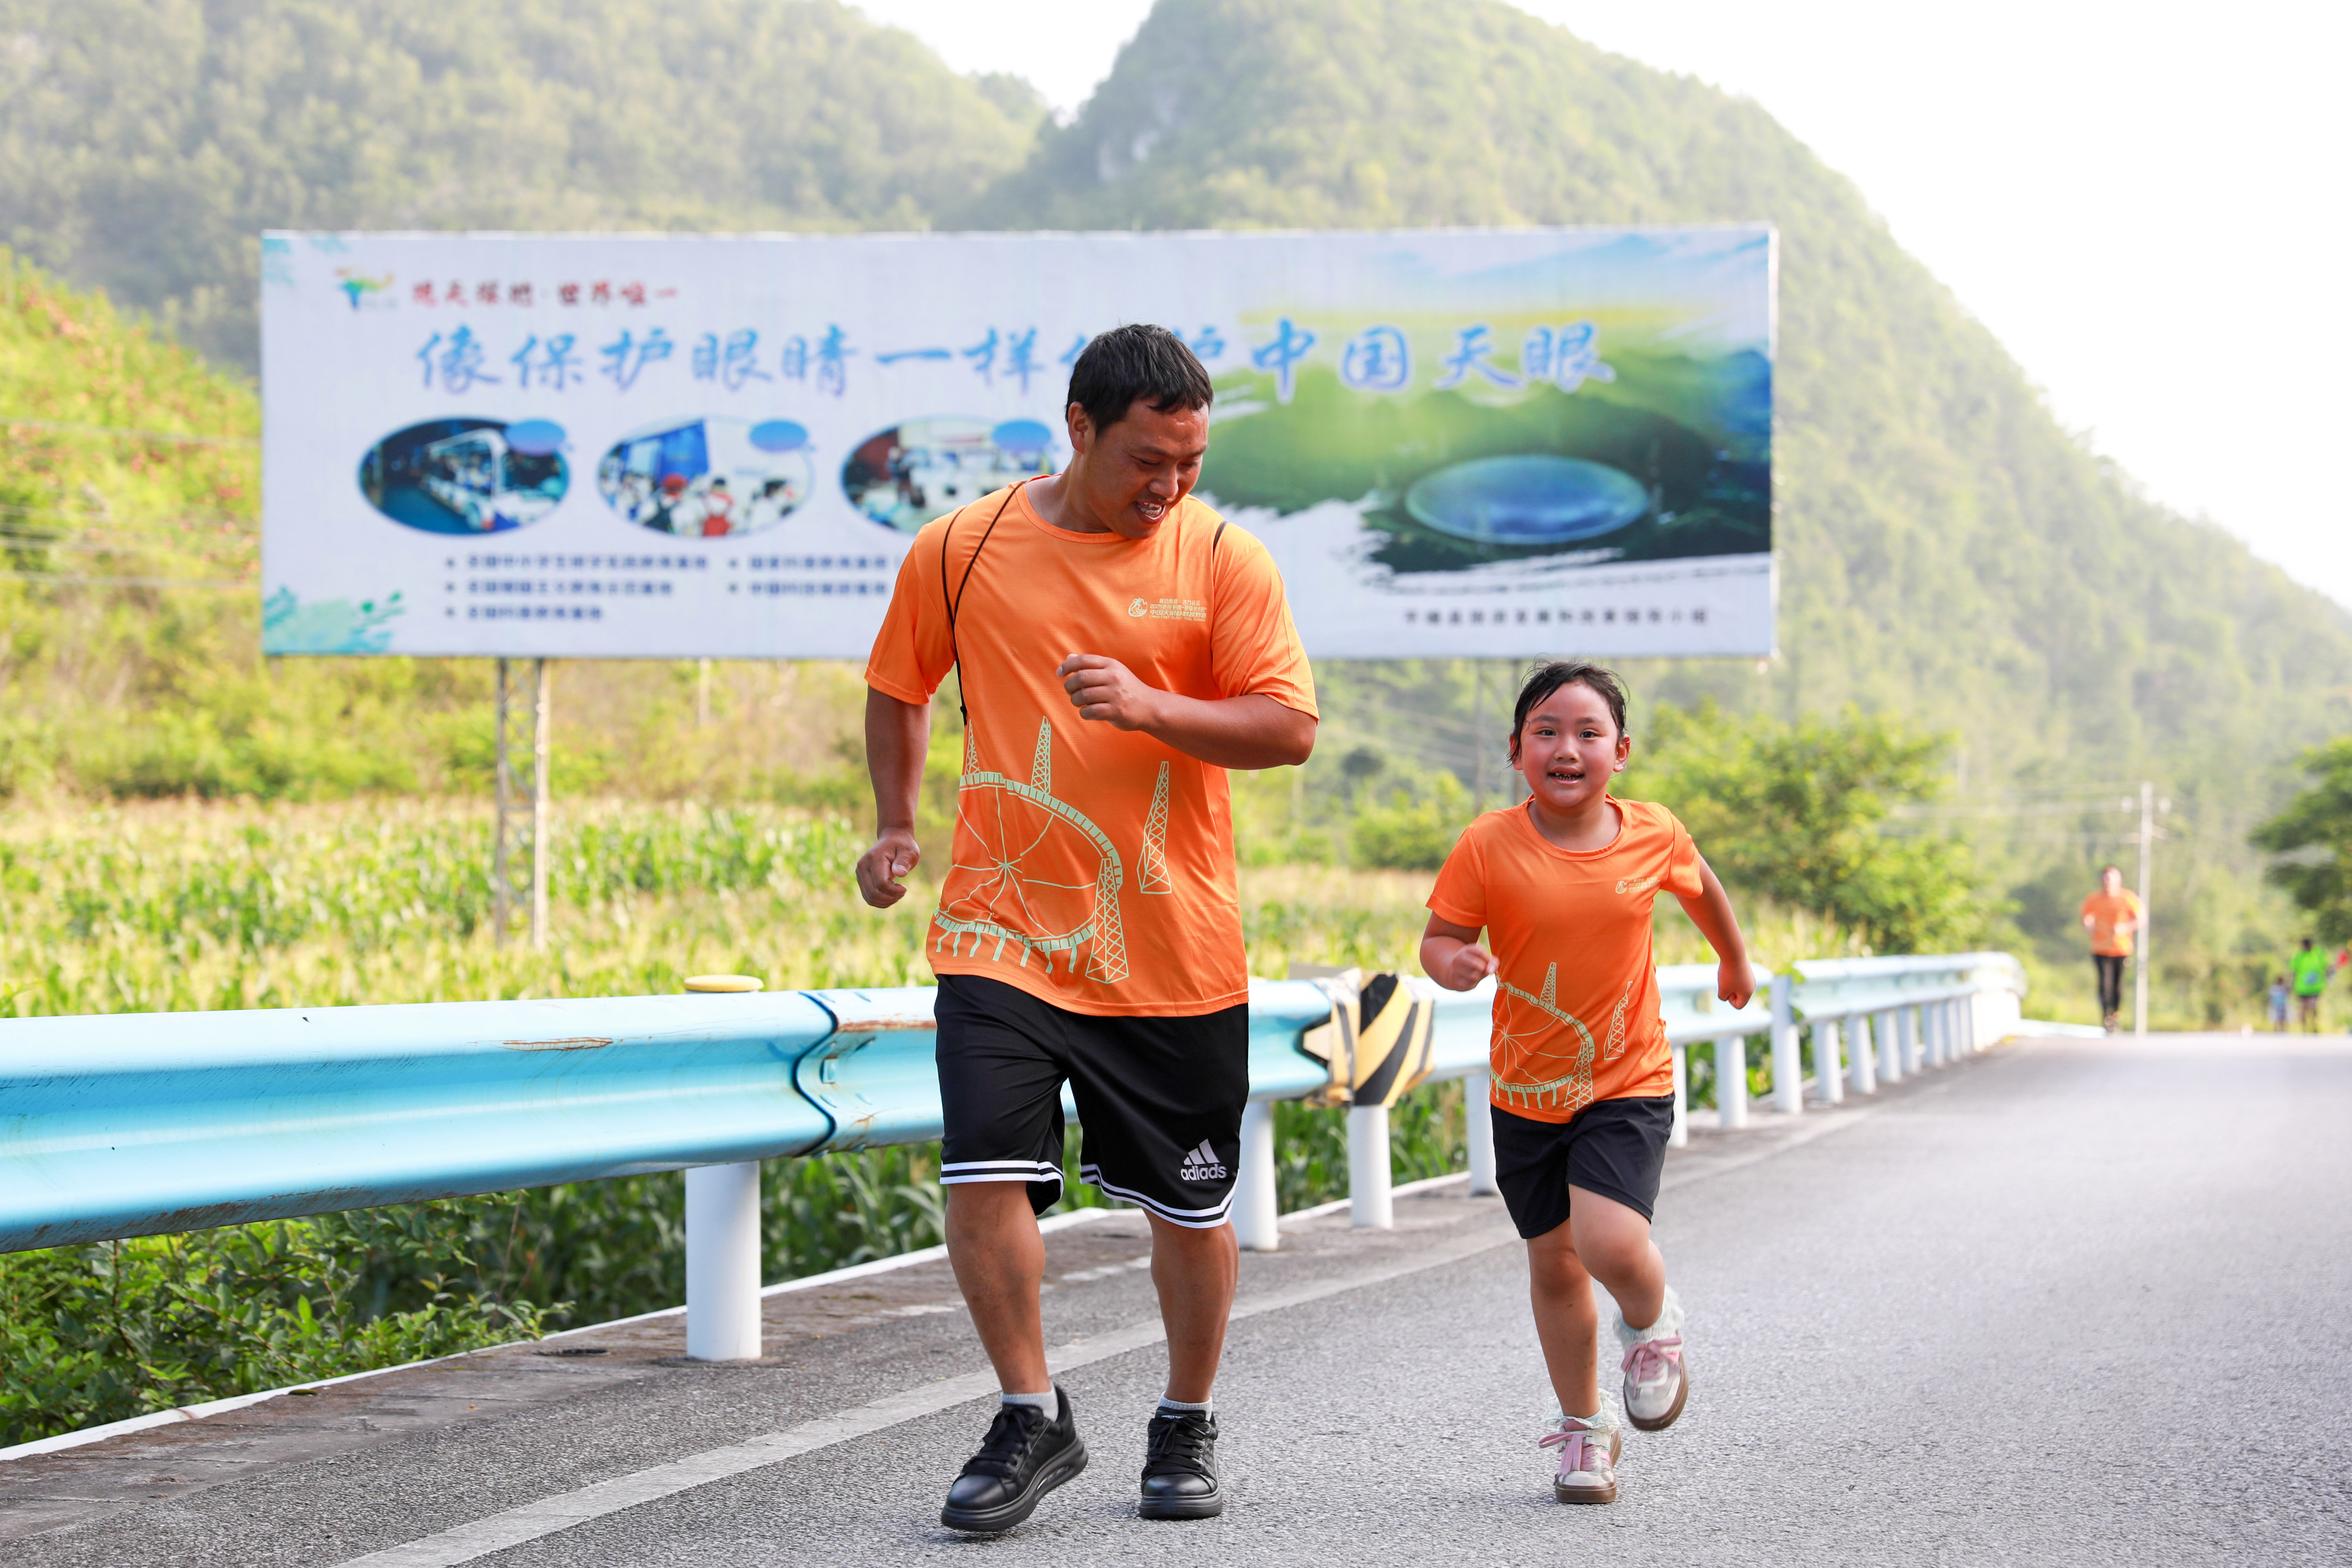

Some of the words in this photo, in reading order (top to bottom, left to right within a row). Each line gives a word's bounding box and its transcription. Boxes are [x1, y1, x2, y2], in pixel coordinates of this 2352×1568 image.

[415, 317, 1616, 403] 像保护眼睛一样中国天眼
[1180, 1164, 1227, 1181] adiads
